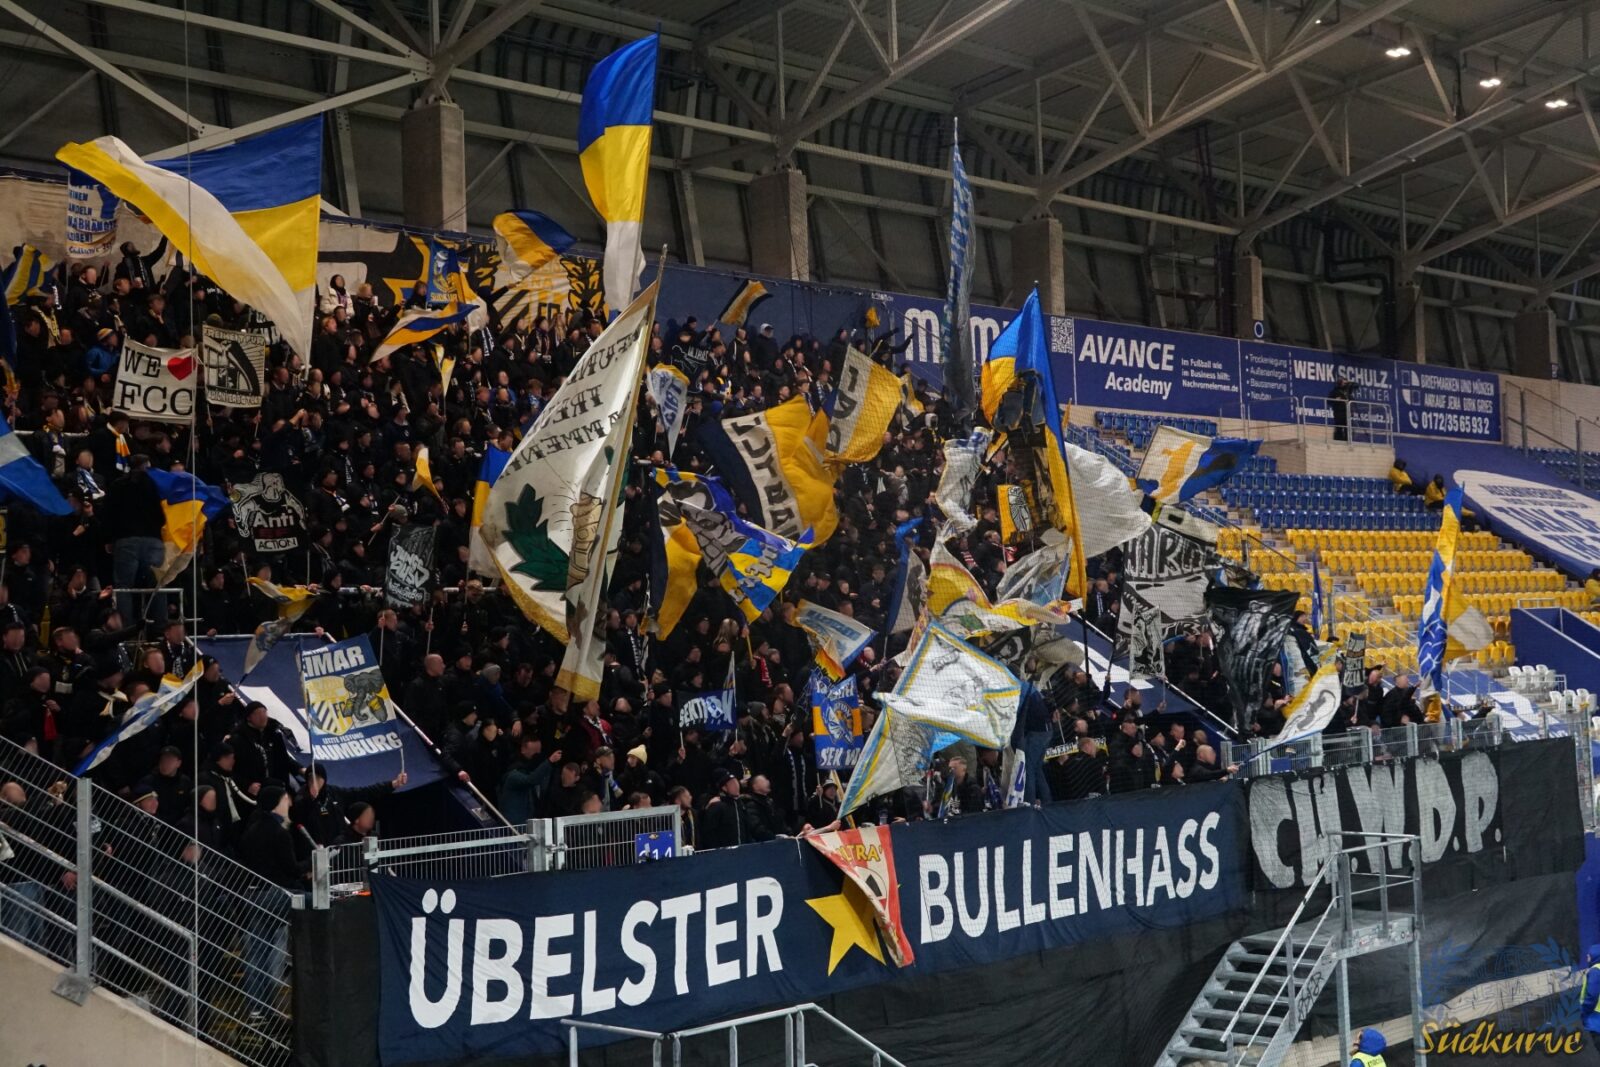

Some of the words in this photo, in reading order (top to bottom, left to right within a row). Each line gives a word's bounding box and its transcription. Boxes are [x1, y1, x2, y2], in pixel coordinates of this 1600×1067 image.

[124, 346, 161, 378] WE
[1079, 334, 1176, 371] AVANCE
[1190, 358, 1211, 368] Fußball
[1105, 371, 1172, 400] Academy
[1182, 379, 1238, 393] Nachvornelernen.de
[1190, 371, 1216, 380] Business
[1293, 360, 1335, 382] WENK
[1337, 365, 1393, 389] SCHULZ.
[1421, 374, 1459, 392] BRIEFMARKEN
[1460, 379, 1472, 393] UND
[1472, 379, 1494, 396] MÜNZEN
[115, 380, 192, 415] FCC
[1447, 396, 1461, 410] JENA
[253, 509, 294, 528] Anti
[258, 538, 297, 549] ACTION
[919, 811, 1220, 944] BULLENHASS
[409, 876, 784, 1029] ÜBELSTER
